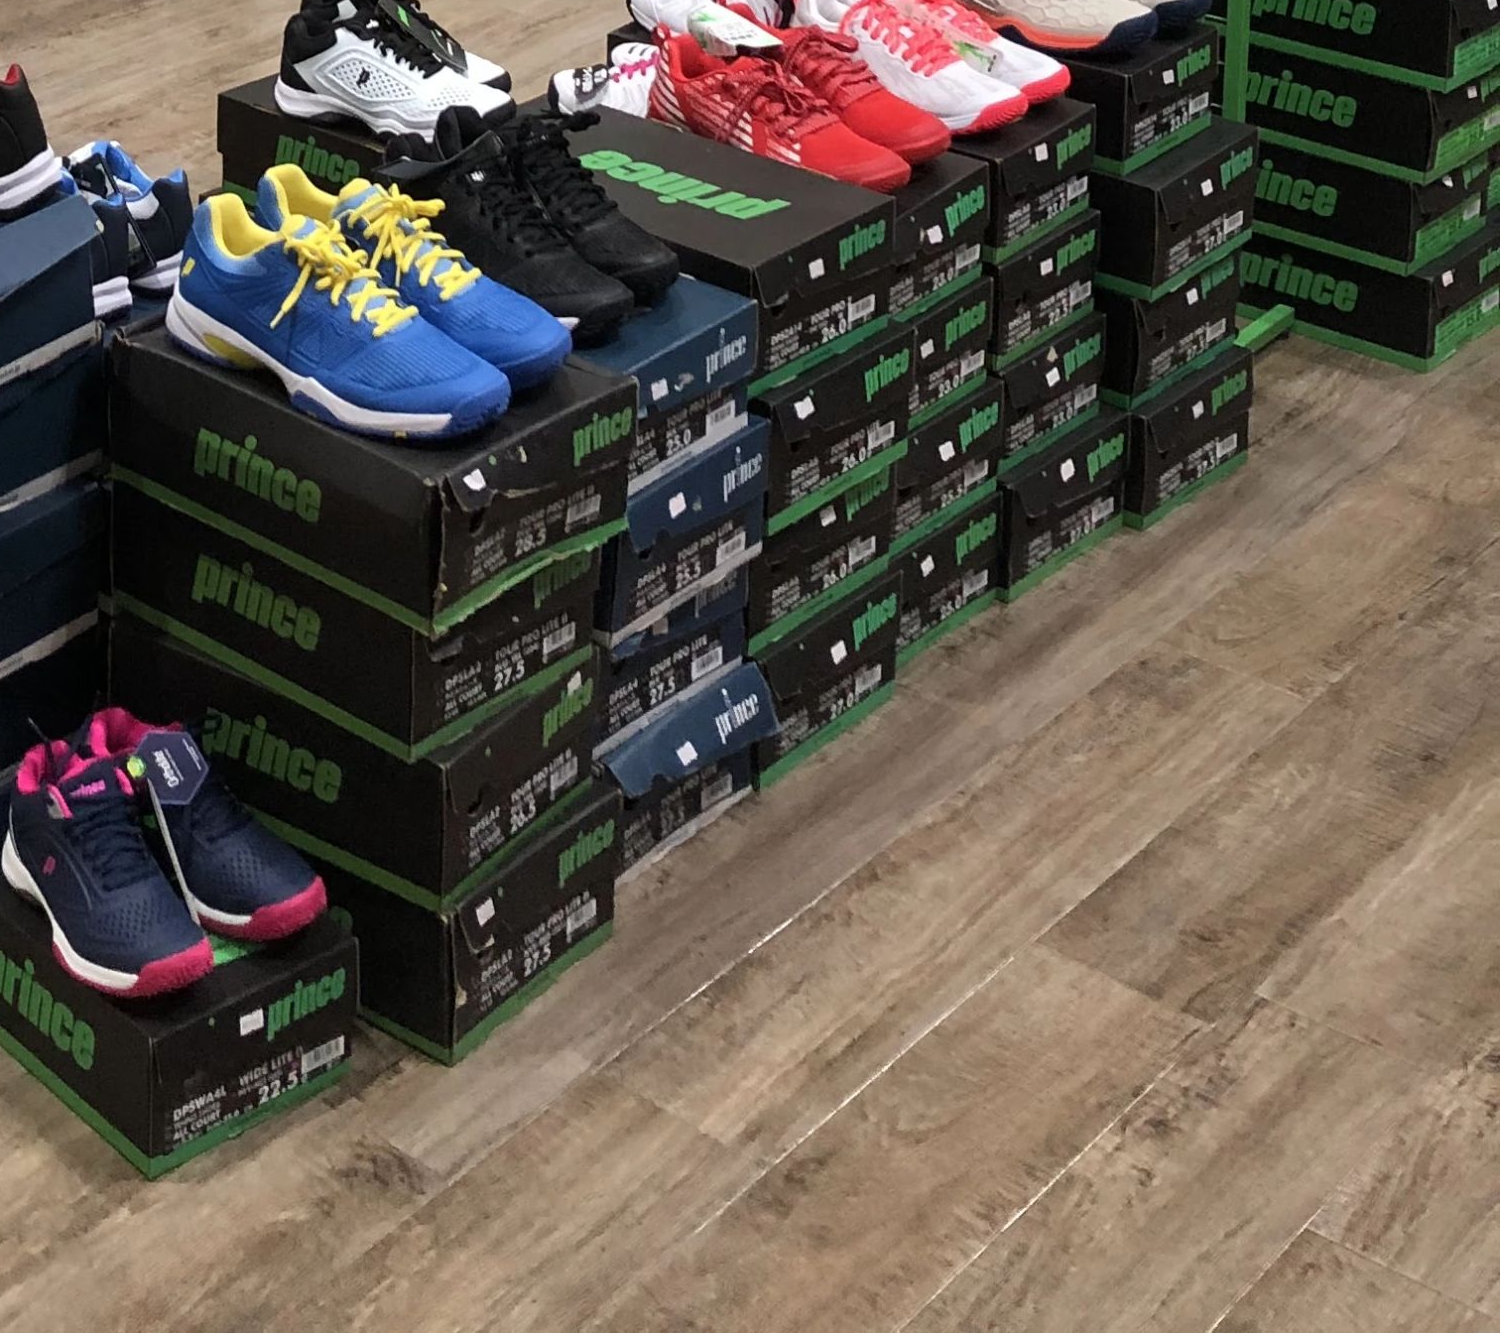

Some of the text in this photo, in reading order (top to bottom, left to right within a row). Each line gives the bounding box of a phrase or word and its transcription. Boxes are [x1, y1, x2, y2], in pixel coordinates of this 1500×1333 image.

[1175, 44, 1212, 87] prince
[276, 133, 360, 186] prince
[1056, 123, 1092, 171] prince
[1219, 145, 1254, 190] prince
[578, 148, 793, 220] prince
[944, 184, 986, 237] prince
[1256, 158, 1339, 218] ince
[838, 219, 886, 272] prince
[1056, 229, 1096, 277] prince
[1239, 251, 1360, 313] prince
[945, 300, 987, 353] prince
[705, 327, 747, 384] prince
[863, 347, 910, 403] prince
[1063, 334, 1102, 382] prince
[1211, 370, 1248, 417] prince
[572, 406, 633, 468] prince
[958, 401, 999, 454] prince
[194, 428, 323, 523] prince
[722, 445, 764, 504] prince
[1087, 432, 1125, 484] prince
[955, 512, 997, 567] prince
[191, 550, 321, 652] prince
[852, 593, 898, 652] prince
[494, 659, 525, 692] 27.5
[714, 687, 761, 746] prince
[202, 706, 344, 805] prince
[558, 819, 616, 889] prince
[266, 965, 347, 1043] prince
[239, 1062, 269, 1088] WIDE
[258, 1069, 299, 1107] 22.5
[190, 1108, 221, 1131] COURT
